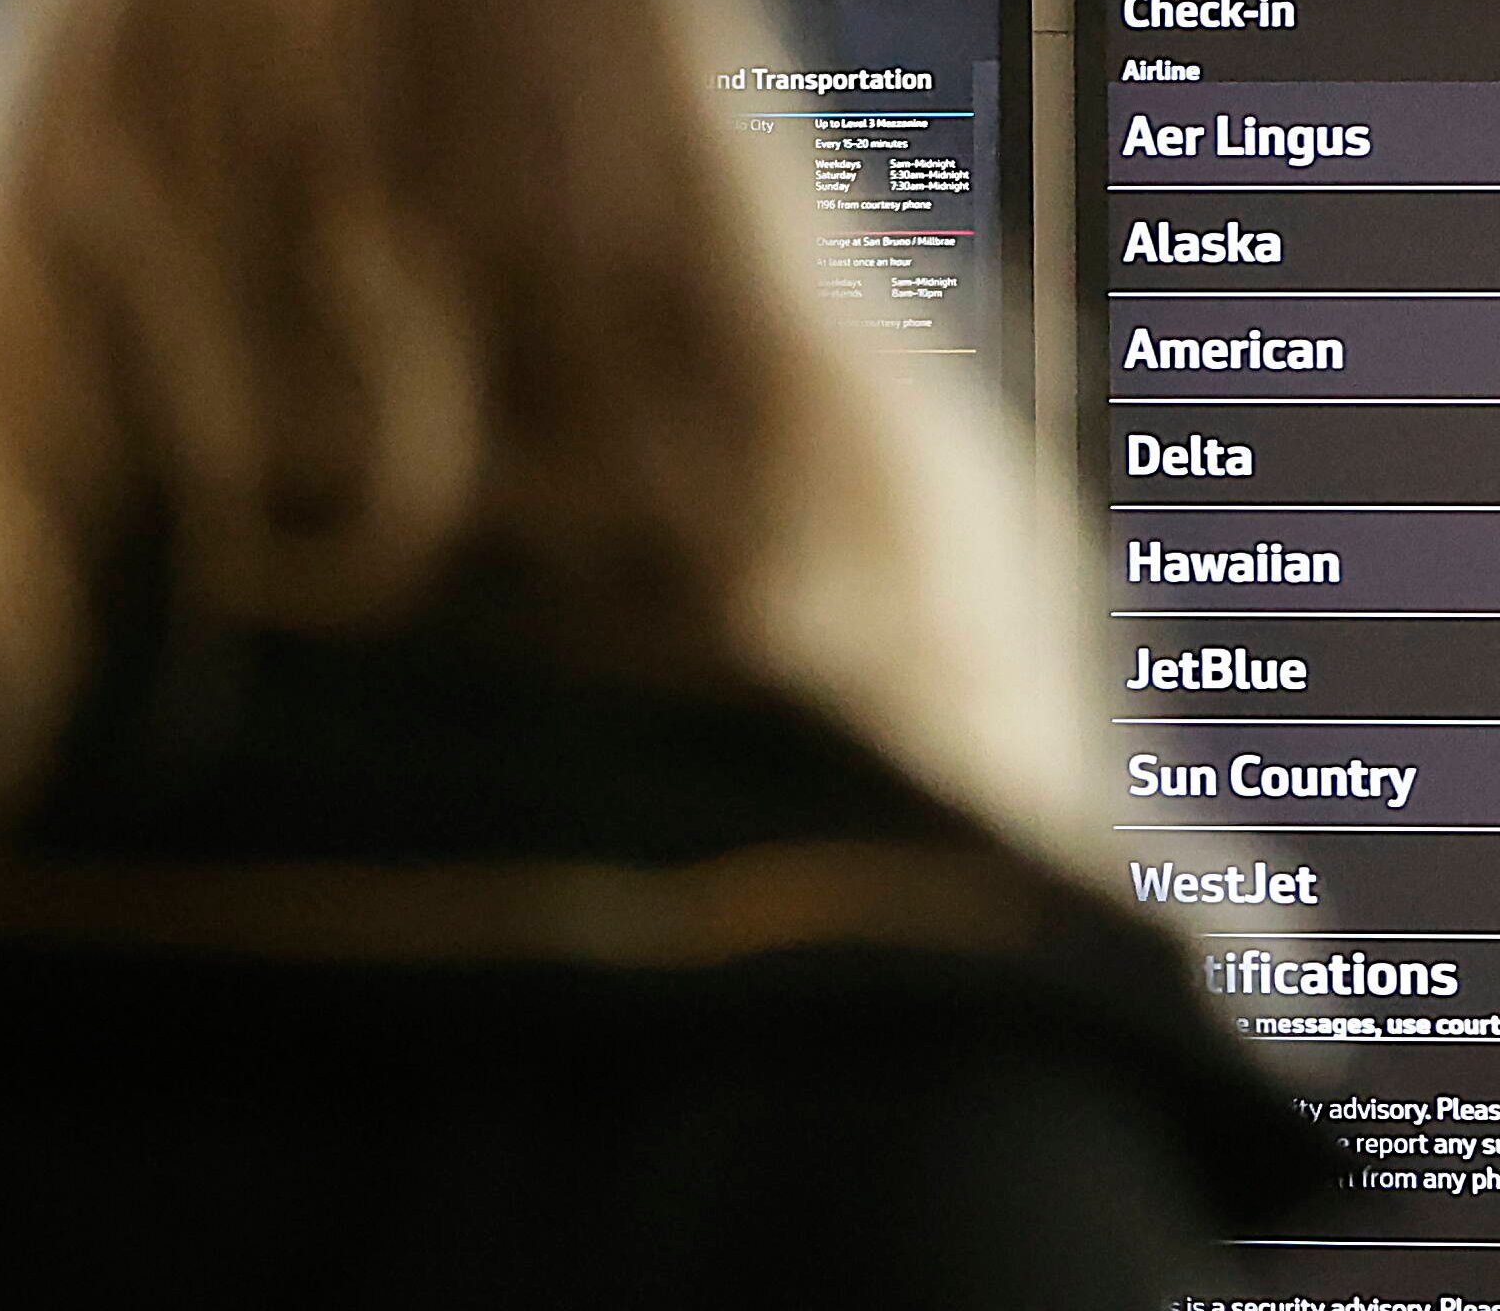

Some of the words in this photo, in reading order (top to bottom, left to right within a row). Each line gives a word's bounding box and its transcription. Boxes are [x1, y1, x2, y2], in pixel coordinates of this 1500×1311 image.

[1121, 59, 1201, 81] Airline
[1122, 115, 1205, 157] Aer
[1216, 115, 1371, 167] Lingus
[1122, 221, 1281, 263] Alaska
[1123, 328, 1344, 370] American
[1128, 434, 1253, 476] Delta
[1129, 541, 1340, 583] Hawaiian
[1126, 647, 1307, 690] JetBlue
[1127, 754, 1217, 797] Sun
[1230, 754, 1417, 808] Country
[1130, 862, 1318, 904] WestJet
[1204, 948, 1461, 999] tifications
